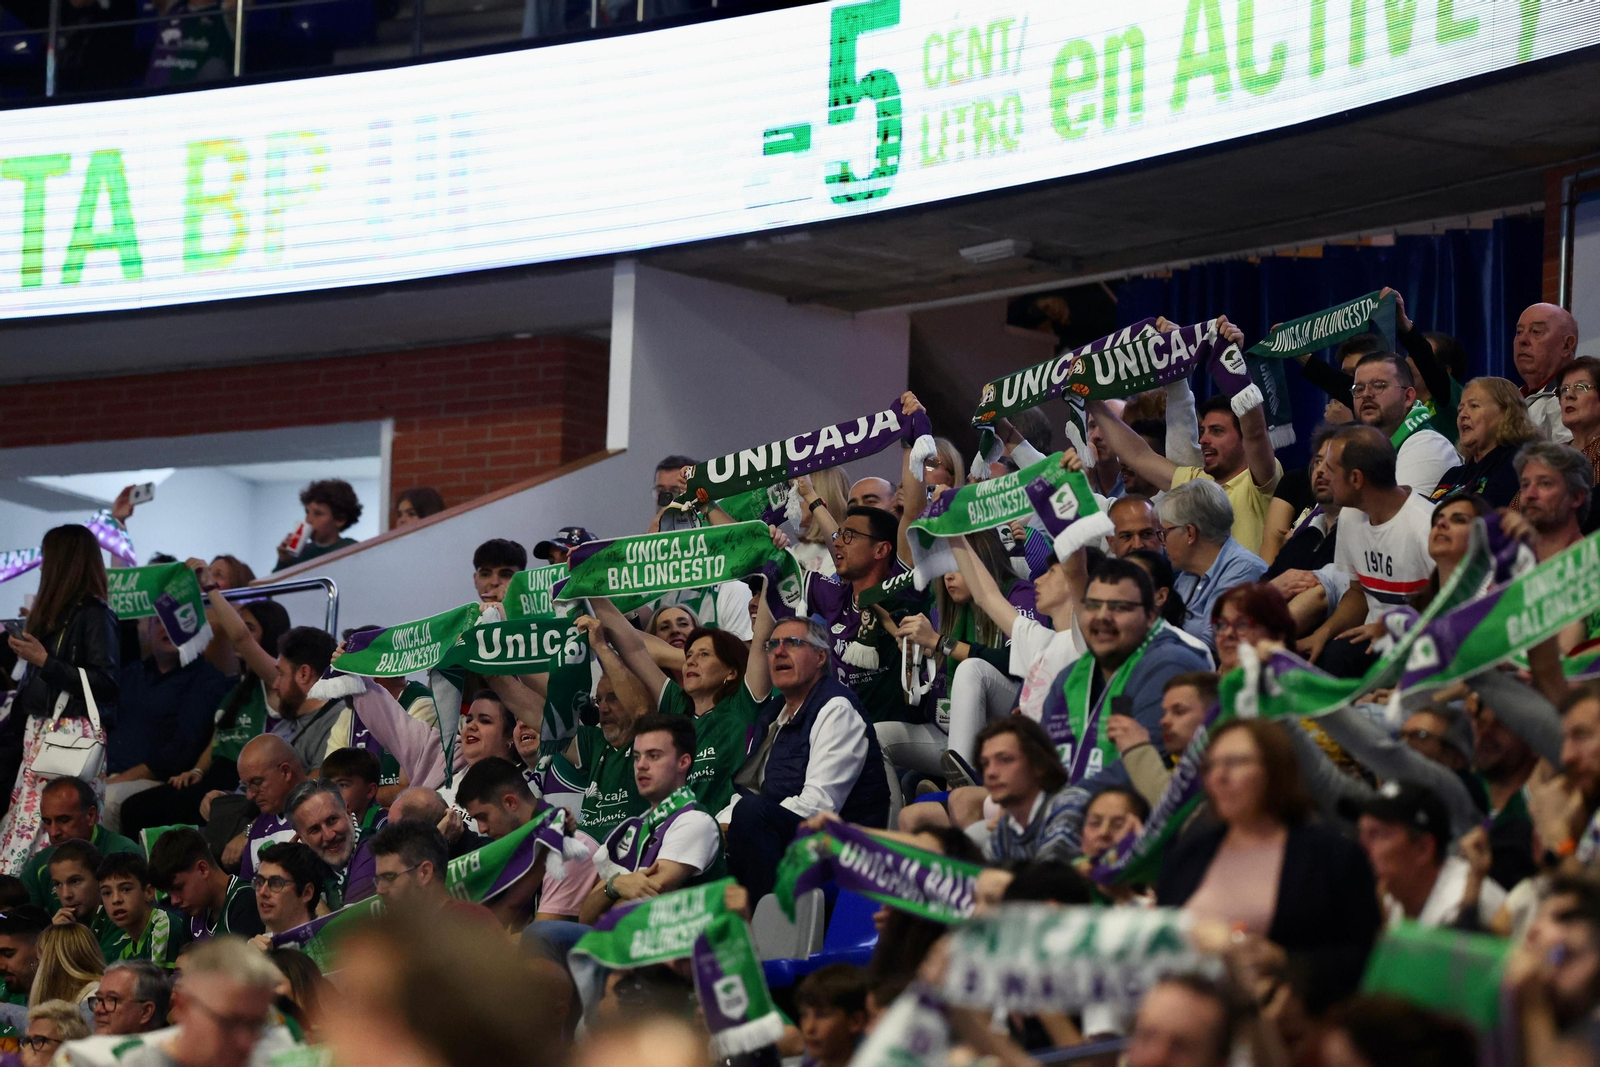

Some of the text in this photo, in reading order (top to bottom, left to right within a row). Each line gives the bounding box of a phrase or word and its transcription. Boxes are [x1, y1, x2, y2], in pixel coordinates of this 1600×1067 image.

[1050, 25, 1145, 140] en
[1270, 298, 1373, 352] UNICAJA BALONCESTO
[707, 409, 901, 484] UNICAJA
[746, 448, 860, 486] BALONCESTO
[975, 472, 1020, 498] UNICAJA
[625, 533, 709, 564] UNICAJA
[1364, 550, 1393, 577] 1976
[607, 555, 726, 591] BALONCESTO
[391, 621, 432, 651] UNICAJA
[375, 641, 442, 673] BALONCESTO
